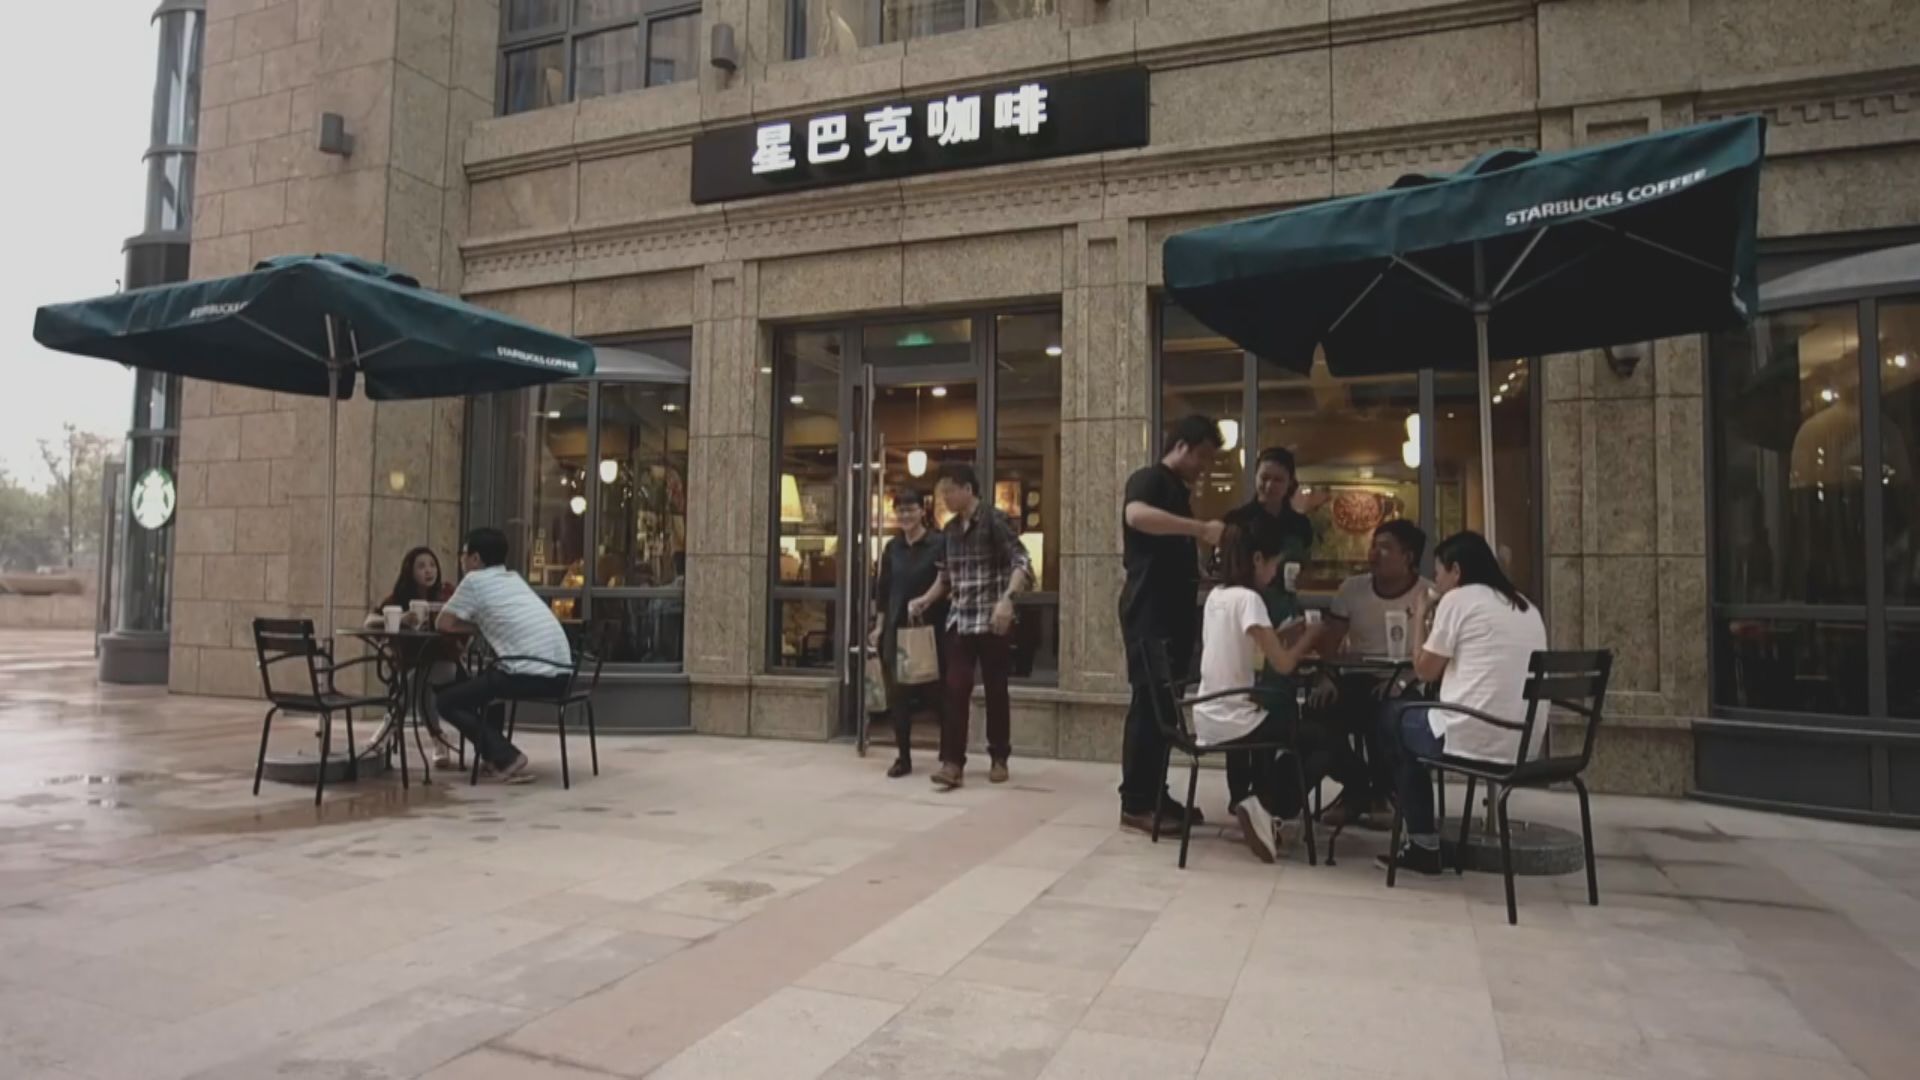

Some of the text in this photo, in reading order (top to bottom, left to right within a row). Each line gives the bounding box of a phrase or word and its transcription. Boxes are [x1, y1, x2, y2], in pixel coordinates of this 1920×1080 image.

[752, 84, 1047, 174] 星巴克咖啡
[1505, 168, 1707, 226] STARBUCKS COFFEE
